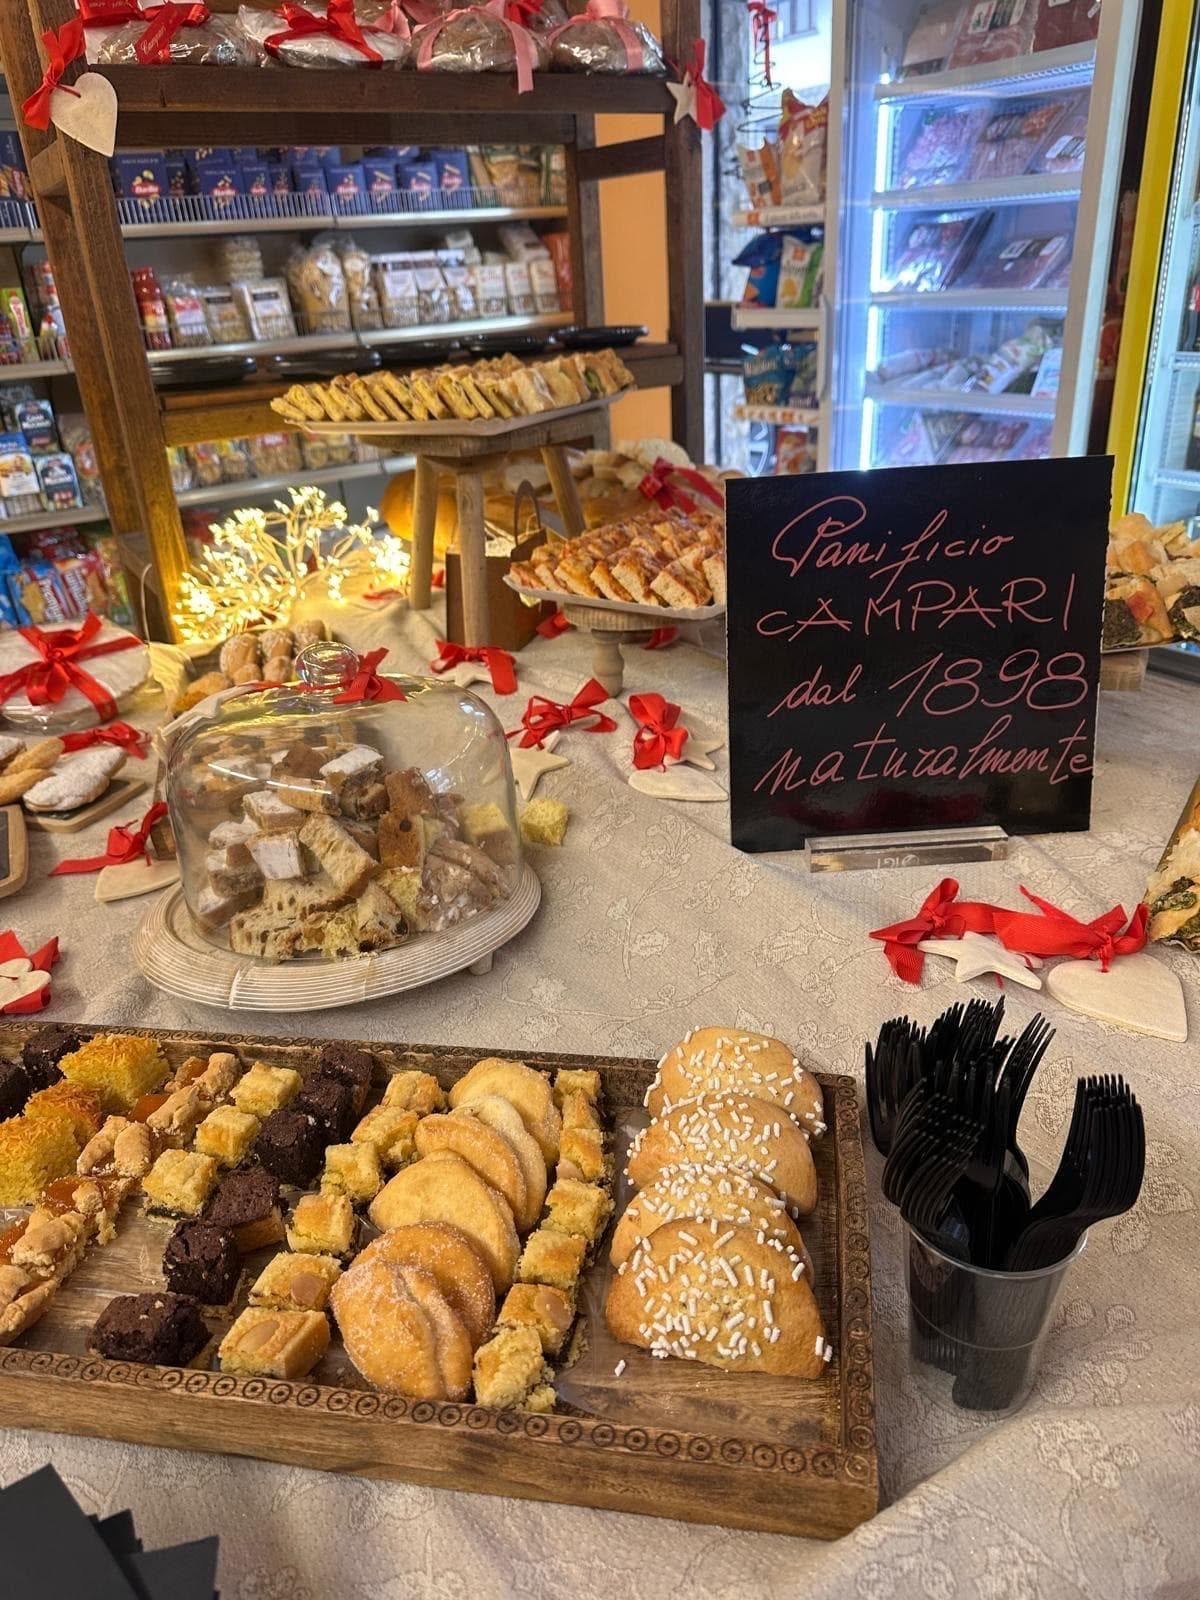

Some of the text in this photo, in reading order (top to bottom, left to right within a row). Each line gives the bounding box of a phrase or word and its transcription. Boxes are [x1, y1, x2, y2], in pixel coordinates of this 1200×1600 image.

[771, 495, 1014, 604] Panificio
[767, 649, 1089, 718] dal 1898
